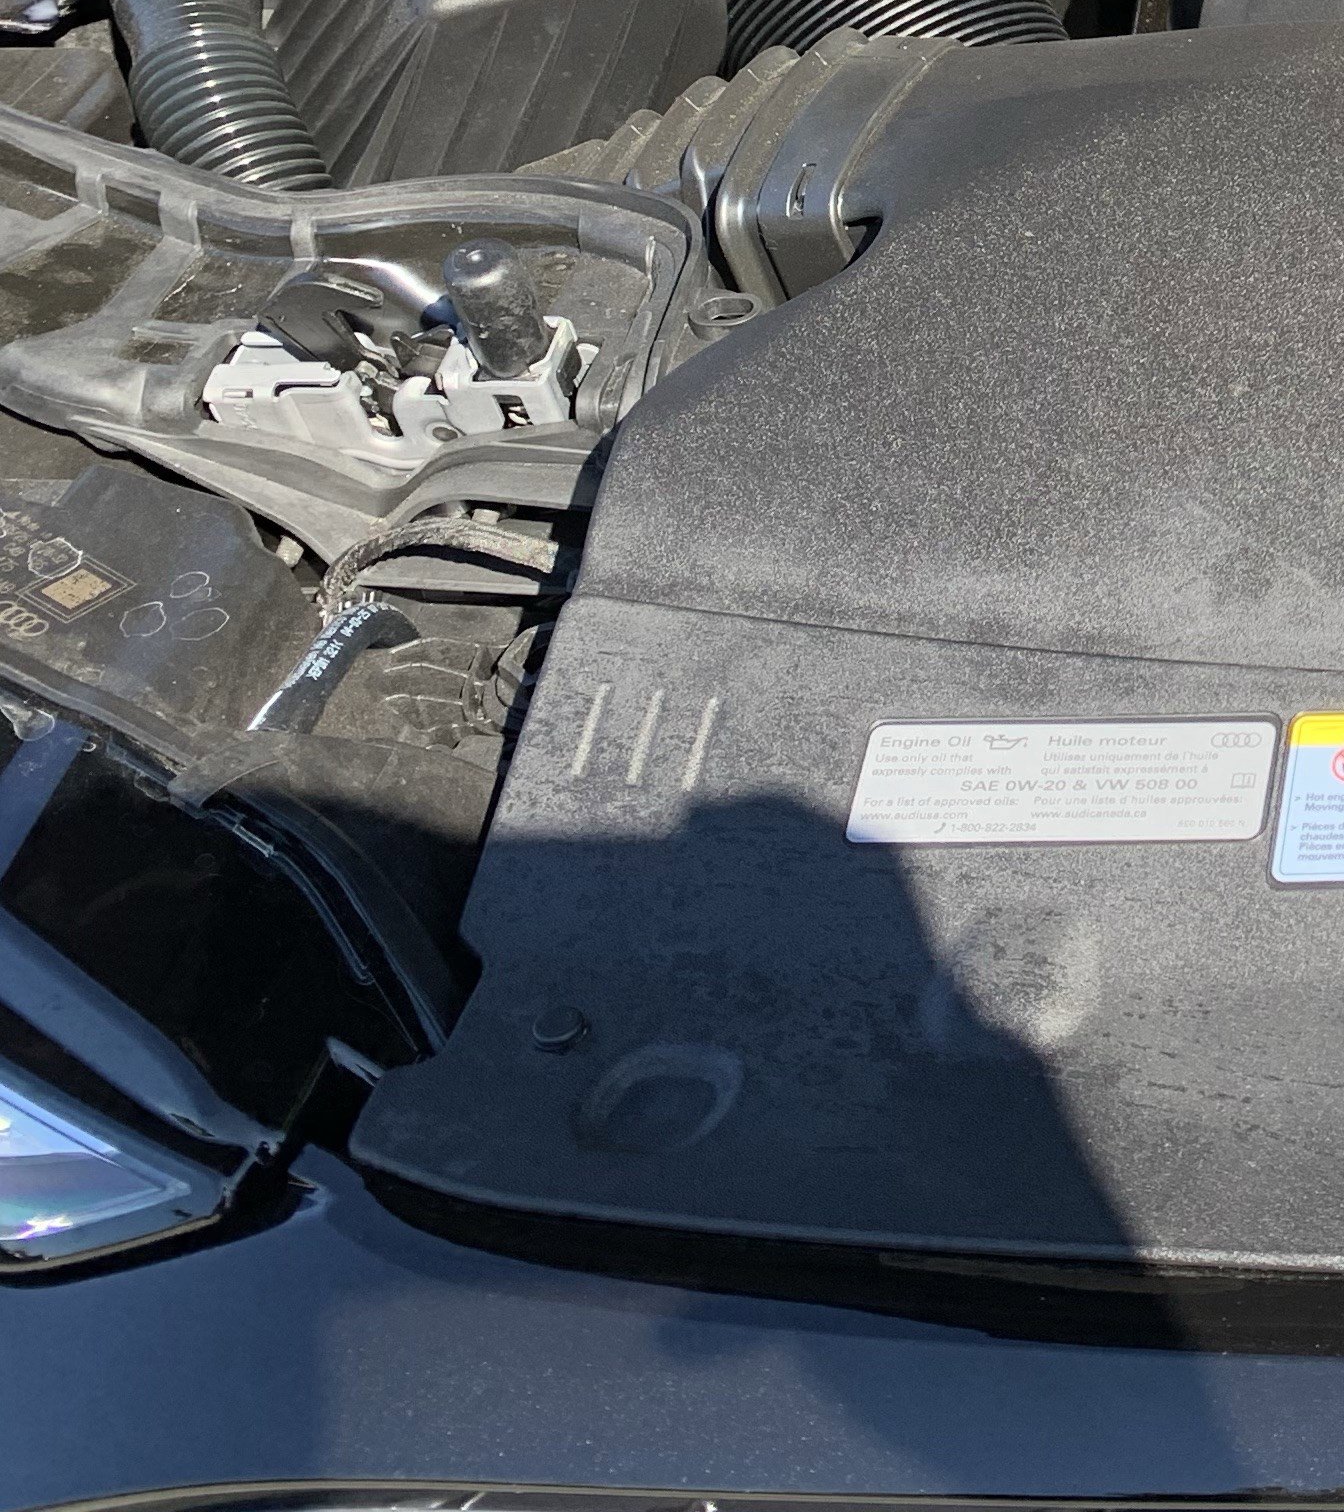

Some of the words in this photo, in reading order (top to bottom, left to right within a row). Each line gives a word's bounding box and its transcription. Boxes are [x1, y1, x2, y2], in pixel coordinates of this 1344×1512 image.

[880, 736, 940, 749] Engine
[948, 736, 972, 747] Oil
[1048, 735, 1093, 747] Huile
[1099, 735, 1167, 747] moteur
[875, 753, 898, 763] Use
[902, 754, 927, 764] only
[931, 753, 947, 762] oil
[950, 753, 973, 762] that
[1090, 751, 1161, 763] uniquement
[1164, 751, 1178, 761] de
[871, 766, 926, 777] expressly
[930, 766, 982, 777] complies
[986, 765, 1012, 775] with
[1041, 765, 1059, 776] qui
[1063, 765, 1110, 775] satisfait
[960, 780, 1000, 792] SAE
[1005, 780, 1066, 792] 0W-20
[1072, 780, 1087, 791] &
[1096, 779, 1130, 790] VW
[1135, 779, 1168, 790] 508
[1175, 779, 1198, 790] 00
[863, 797, 883, 807] For
[897, 796, 915, 806] list
[918, 796, 931, 806] of
[933, 797, 991, 808] approved
[1033, 796, 1061, 805] Pour
[1065, 796, 1087, 805] une
[1091, 796, 1115, 805] liste
[1306, 793, 1325, 801] Hot
[1305, 803, 1344, 812] Moving
